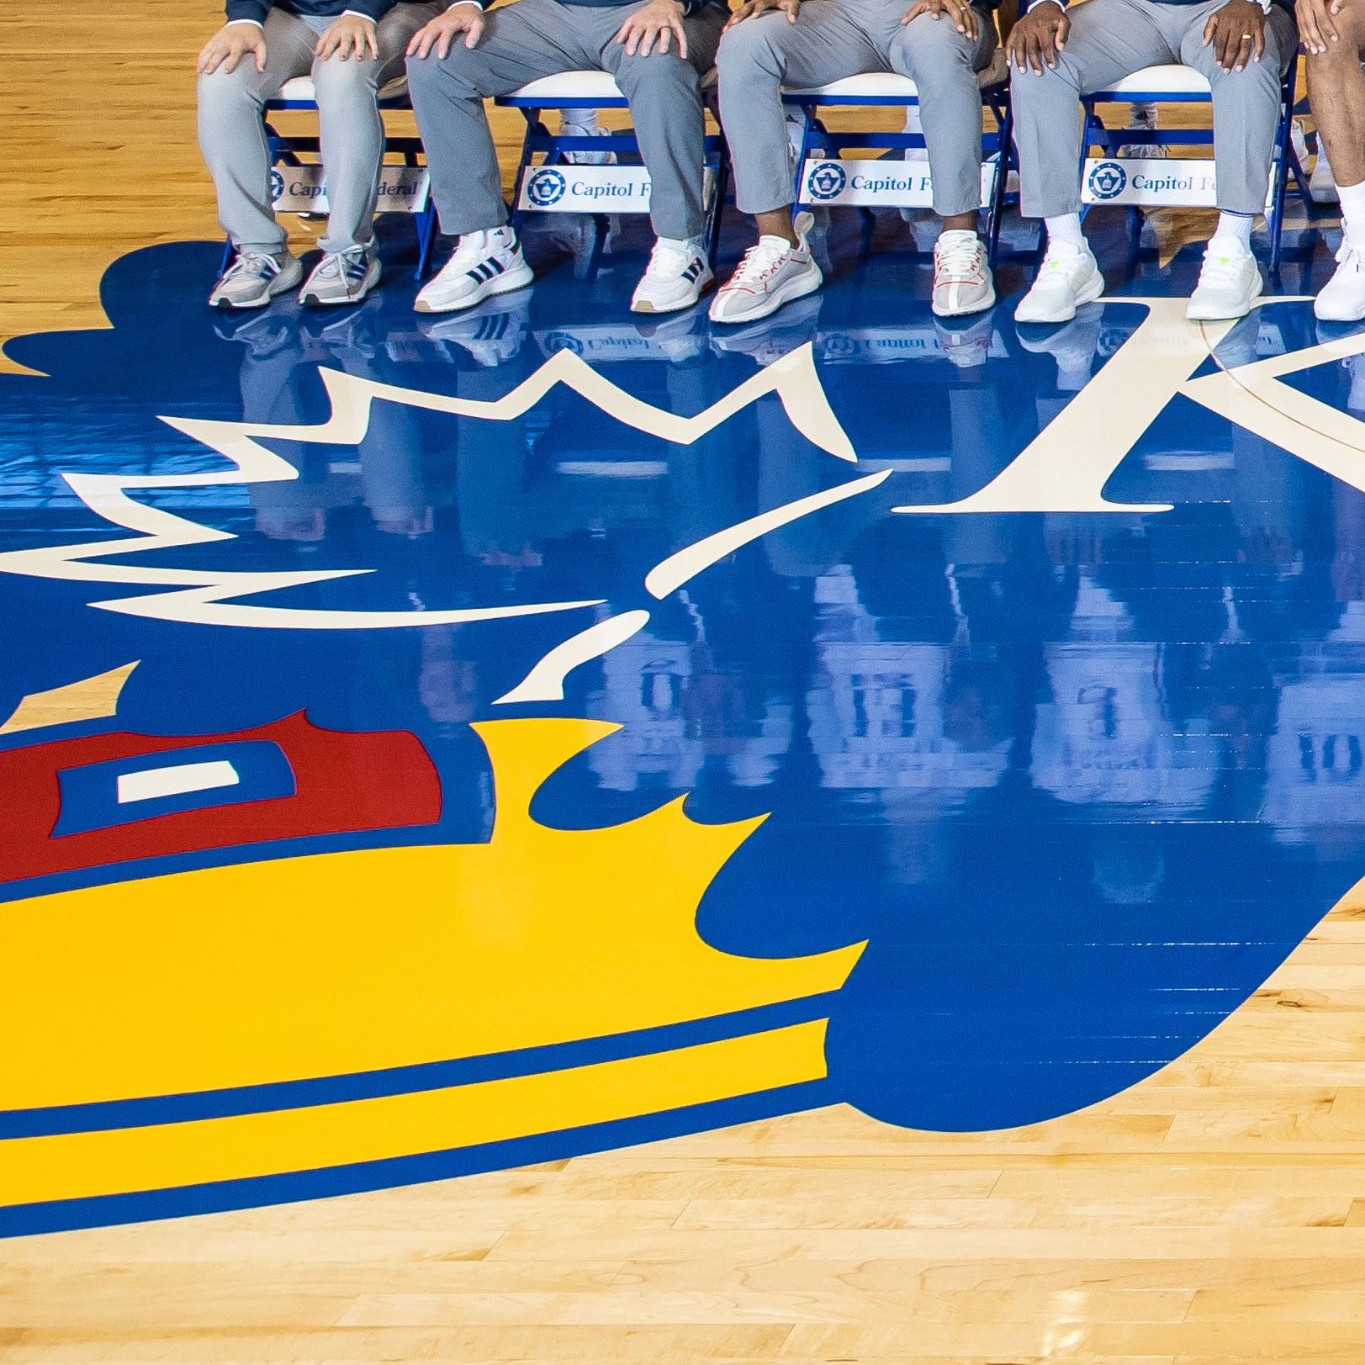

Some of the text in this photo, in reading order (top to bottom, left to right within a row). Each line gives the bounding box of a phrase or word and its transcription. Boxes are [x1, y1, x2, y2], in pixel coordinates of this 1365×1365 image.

[289, 181, 417, 199] Capi deral
[571, 183, 633, 200] Capitol
[851, 176, 912, 193] Capitol
[1131, 174, 1193, 193] Capitol
